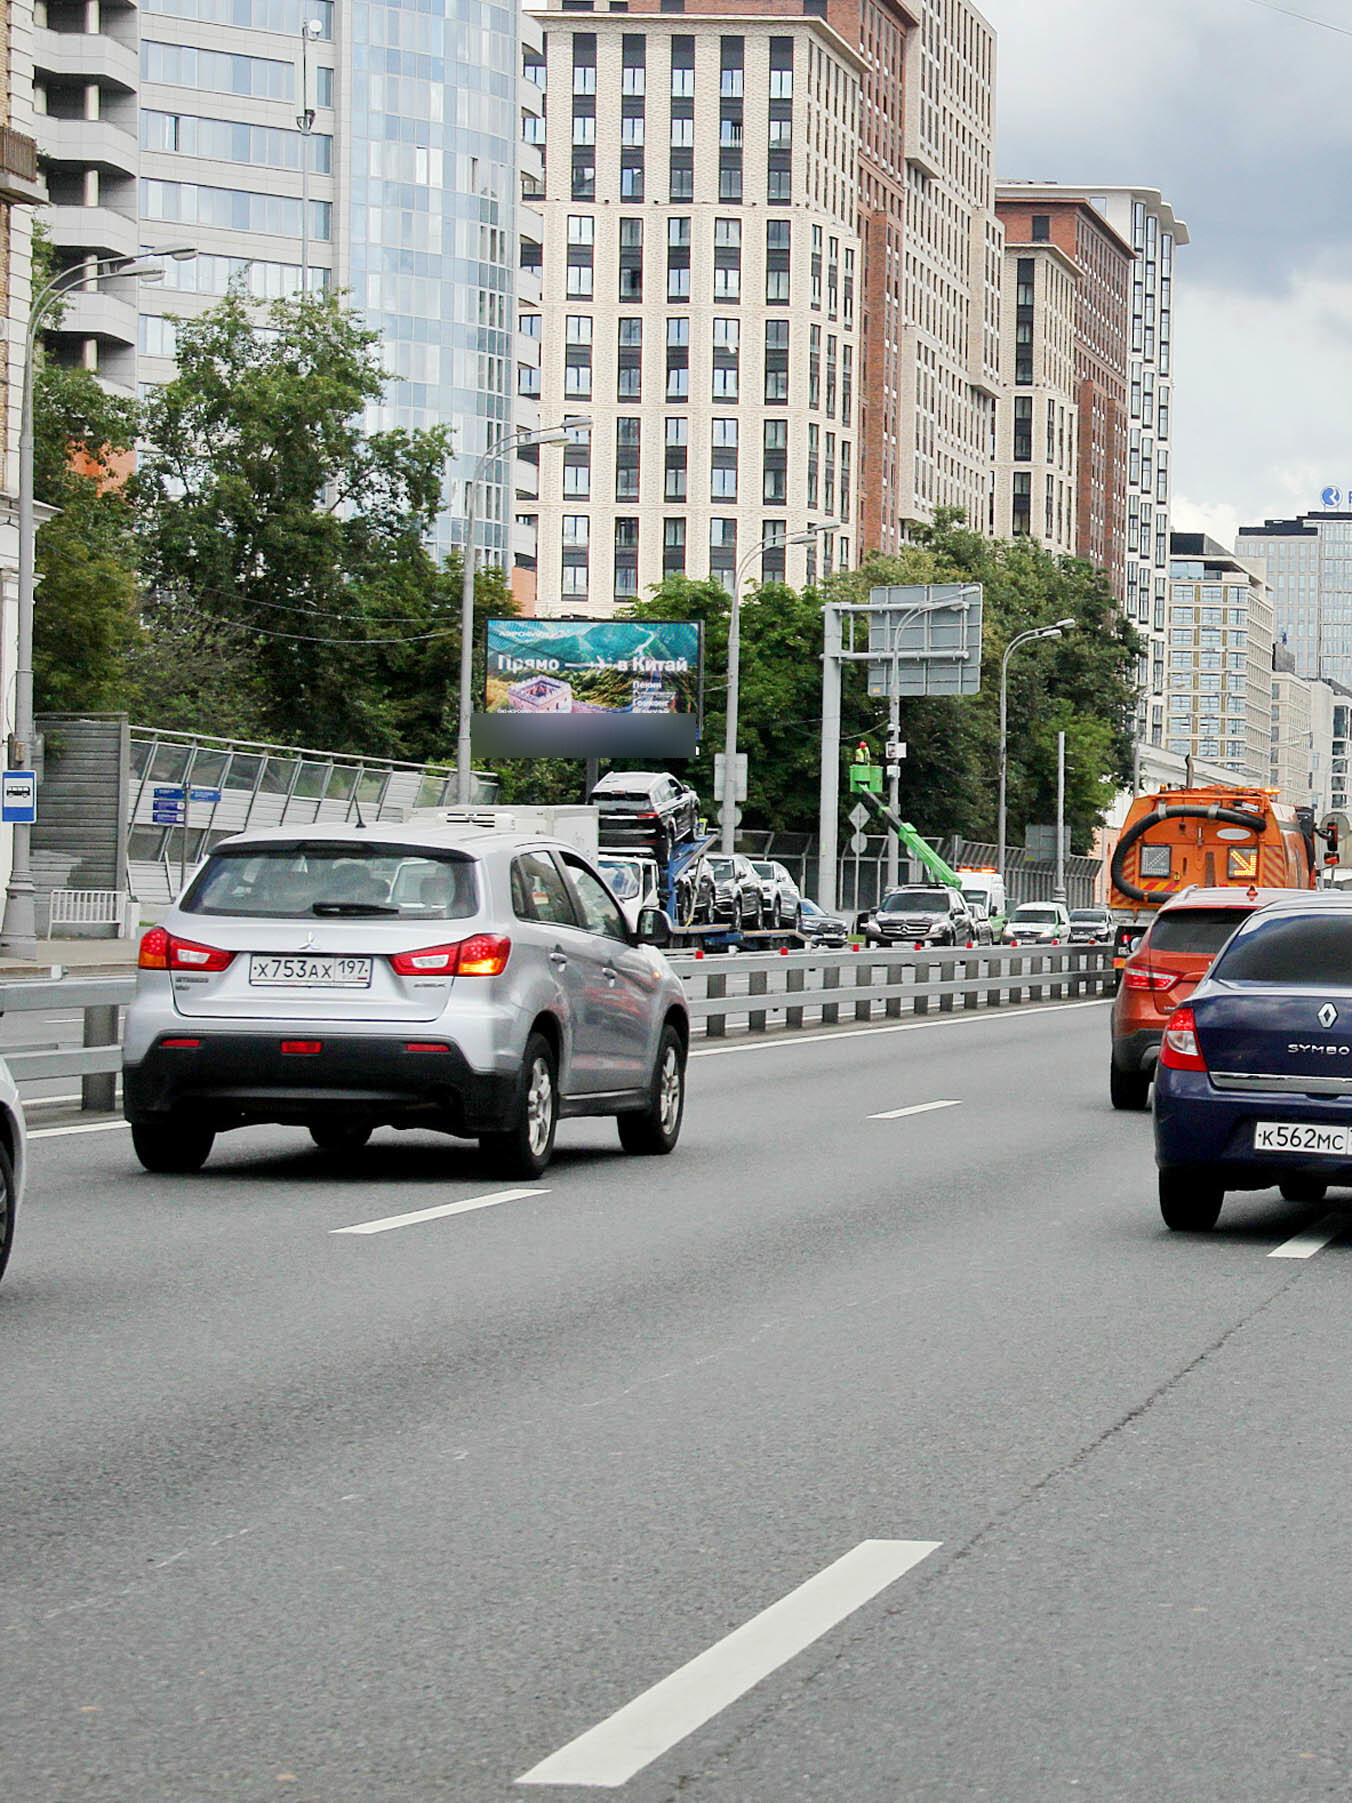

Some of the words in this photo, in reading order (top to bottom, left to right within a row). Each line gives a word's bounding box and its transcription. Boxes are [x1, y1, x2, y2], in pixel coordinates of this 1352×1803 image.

[498, 655, 560, 673] Прямо
[617, 662, 628, 671] в
[632, 657, 688, 672] Китай
[258, 960, 332, 979] Х753АХ
[1262, 1126, 1344, 1150] К562МС
